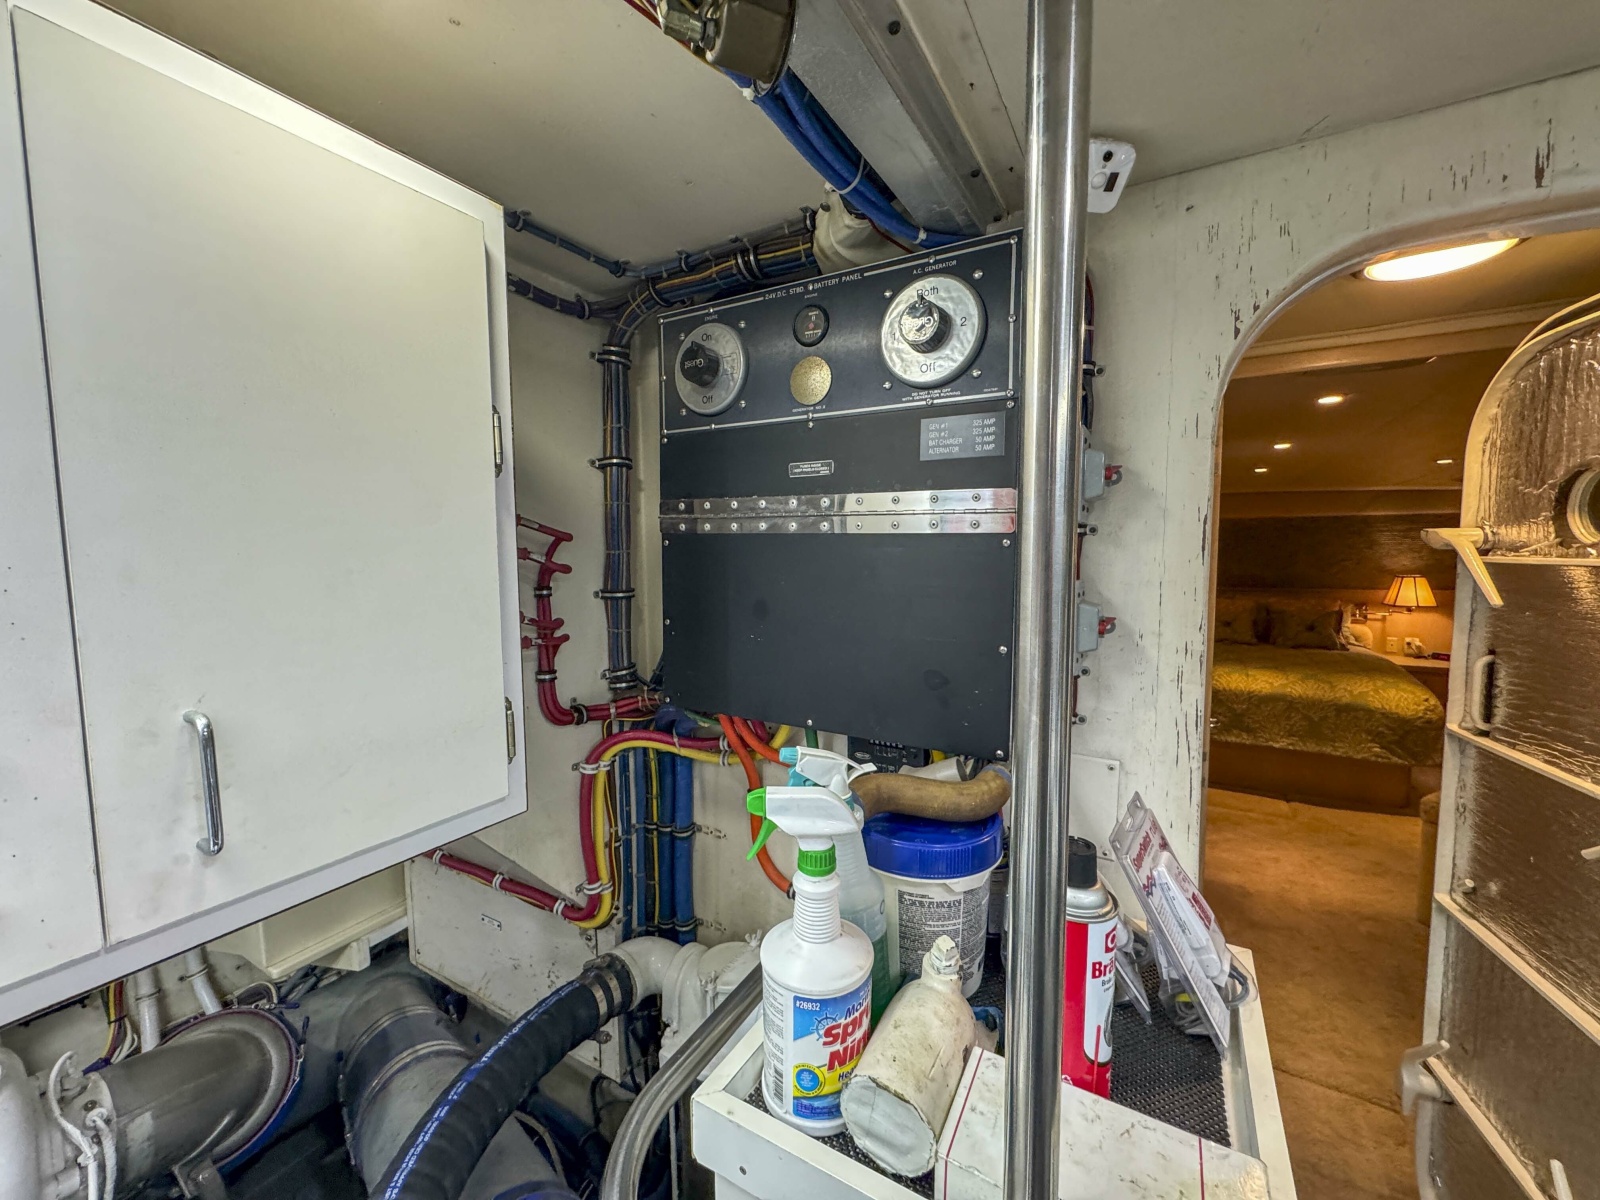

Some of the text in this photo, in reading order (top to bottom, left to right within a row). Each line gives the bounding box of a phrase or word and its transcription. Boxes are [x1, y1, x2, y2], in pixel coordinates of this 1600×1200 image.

[924, 260, 957, 273] GENERATOR
[813, 277, 840, 290] BATTERY
[841, 272, 862, 283] PANEL
[960, 316, 967, 327] 2
[701, 333, 712, 342] On
[684, 358, 704, 370] Guest
[920, 362, 936, 373] Off
[702, 395, 713, 404] Off
[940, 438, 963, 446] CHARGER
[928, 446, 960, 454] ALTERNATOR
[796, 1000, 821, 1011] #26932
